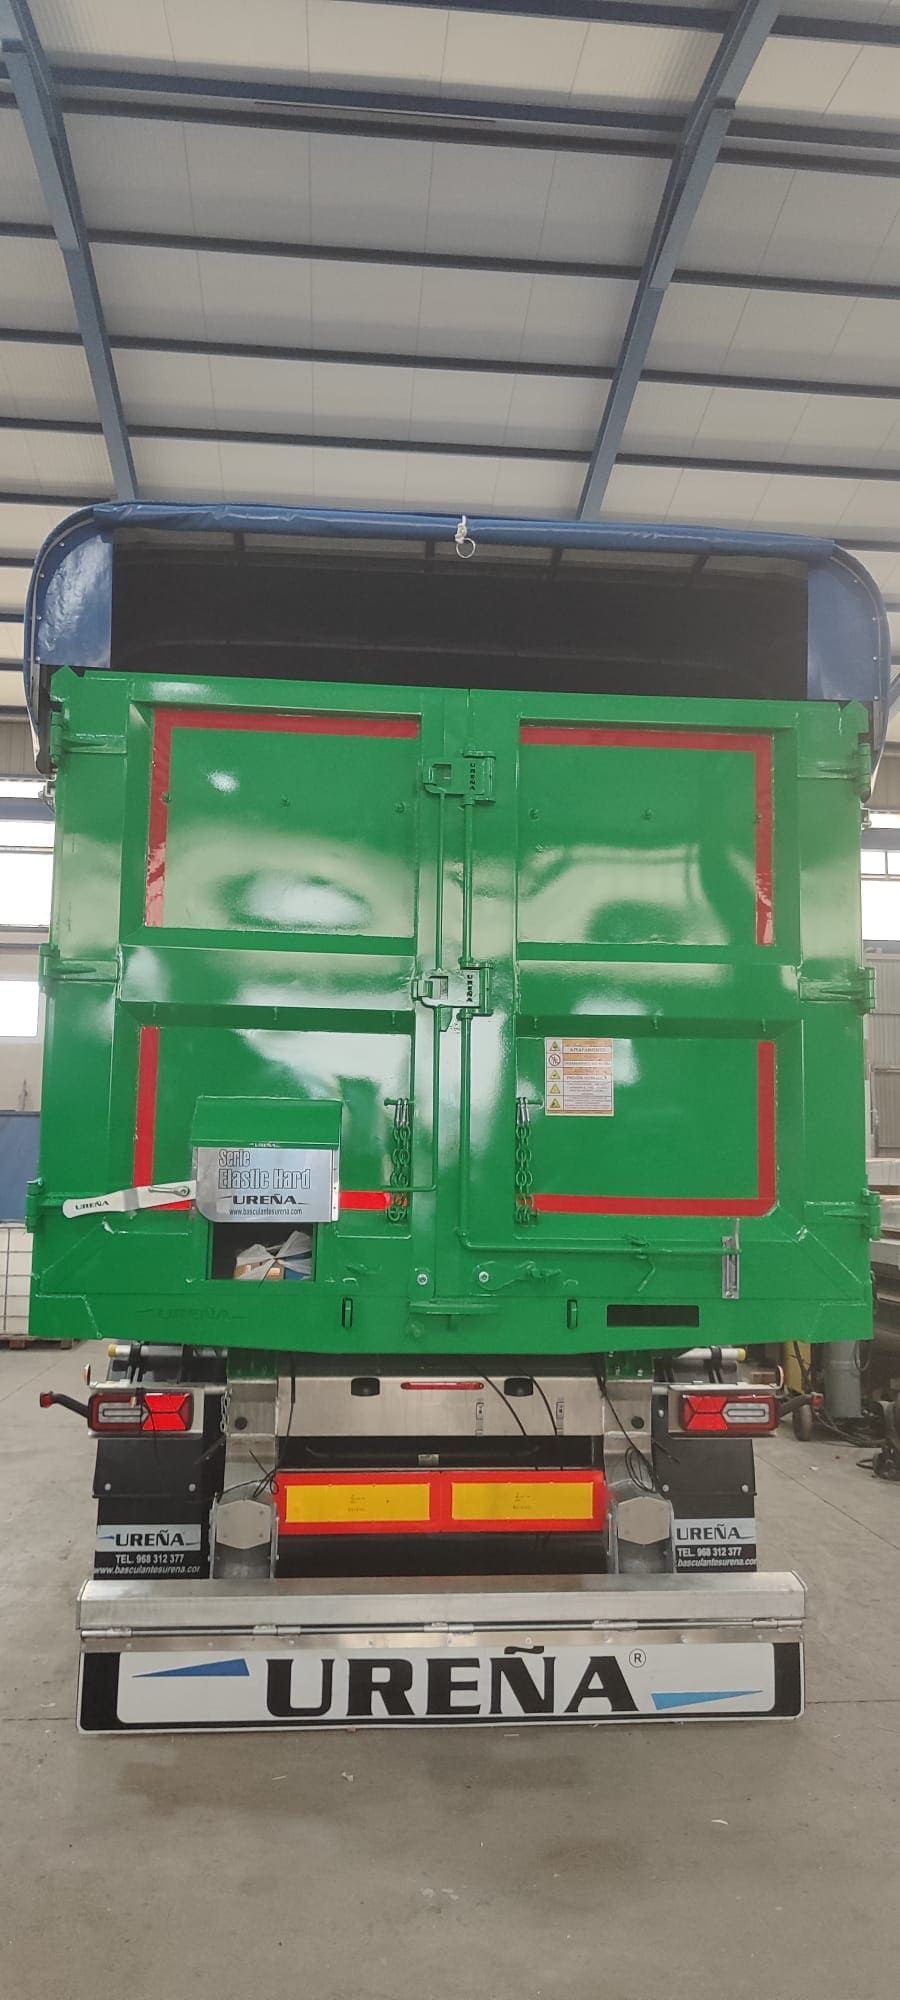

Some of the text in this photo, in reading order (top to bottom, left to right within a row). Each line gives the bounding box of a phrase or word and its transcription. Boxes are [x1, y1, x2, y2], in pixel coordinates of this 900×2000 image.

[218, 1149, 251, 1168] Serie
[217, 1168, 312, 1190] Elastic Hard
[232, 1193, 297, 1205] UREÑA
[115, 1529, 185, 1547] UREÑA
[676, 1523, 741, 1541] UREÑA
[136, 1554, 151, 1564] 968
[153, 1554, 168, 1564] 312
[169, 1553, 185, 1563] 377
[712, 1547, 727, 1557] 312
[728, 1546, 742, 1557] 377
[265, 1645, 640, 1718] UREÑA
